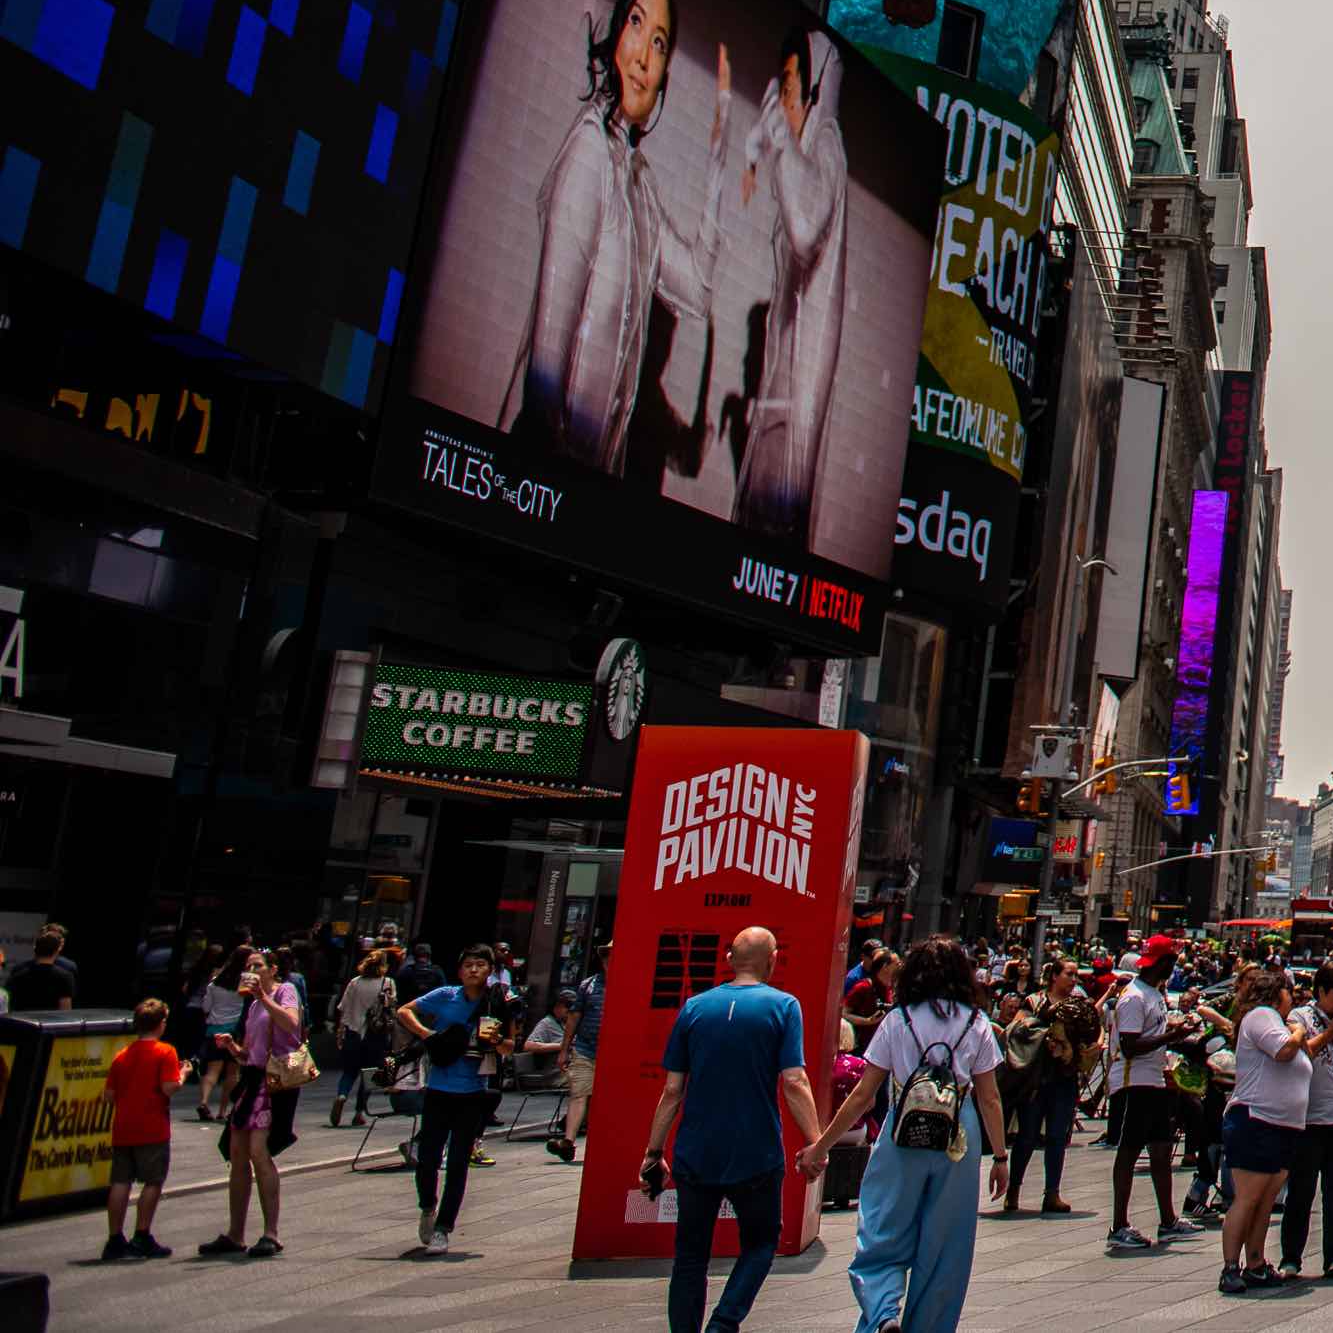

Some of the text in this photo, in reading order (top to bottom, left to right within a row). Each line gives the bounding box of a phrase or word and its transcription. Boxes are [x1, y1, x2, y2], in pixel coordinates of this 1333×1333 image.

[929, 202, 1034, 326] EACH
[422, 440, 563, 522] TALES OF THE CITY
[732, 556, 865, 635] JUNE 7 NETFLIX
[370, 681, 585, 727] STARBUCKS
[401, 719, 537, 756] COFFEE
[660, 762, 791, 836] DESIGN
[791, 782, 817, 841] NYC
[653, 816, 812, 896] PAVILION
